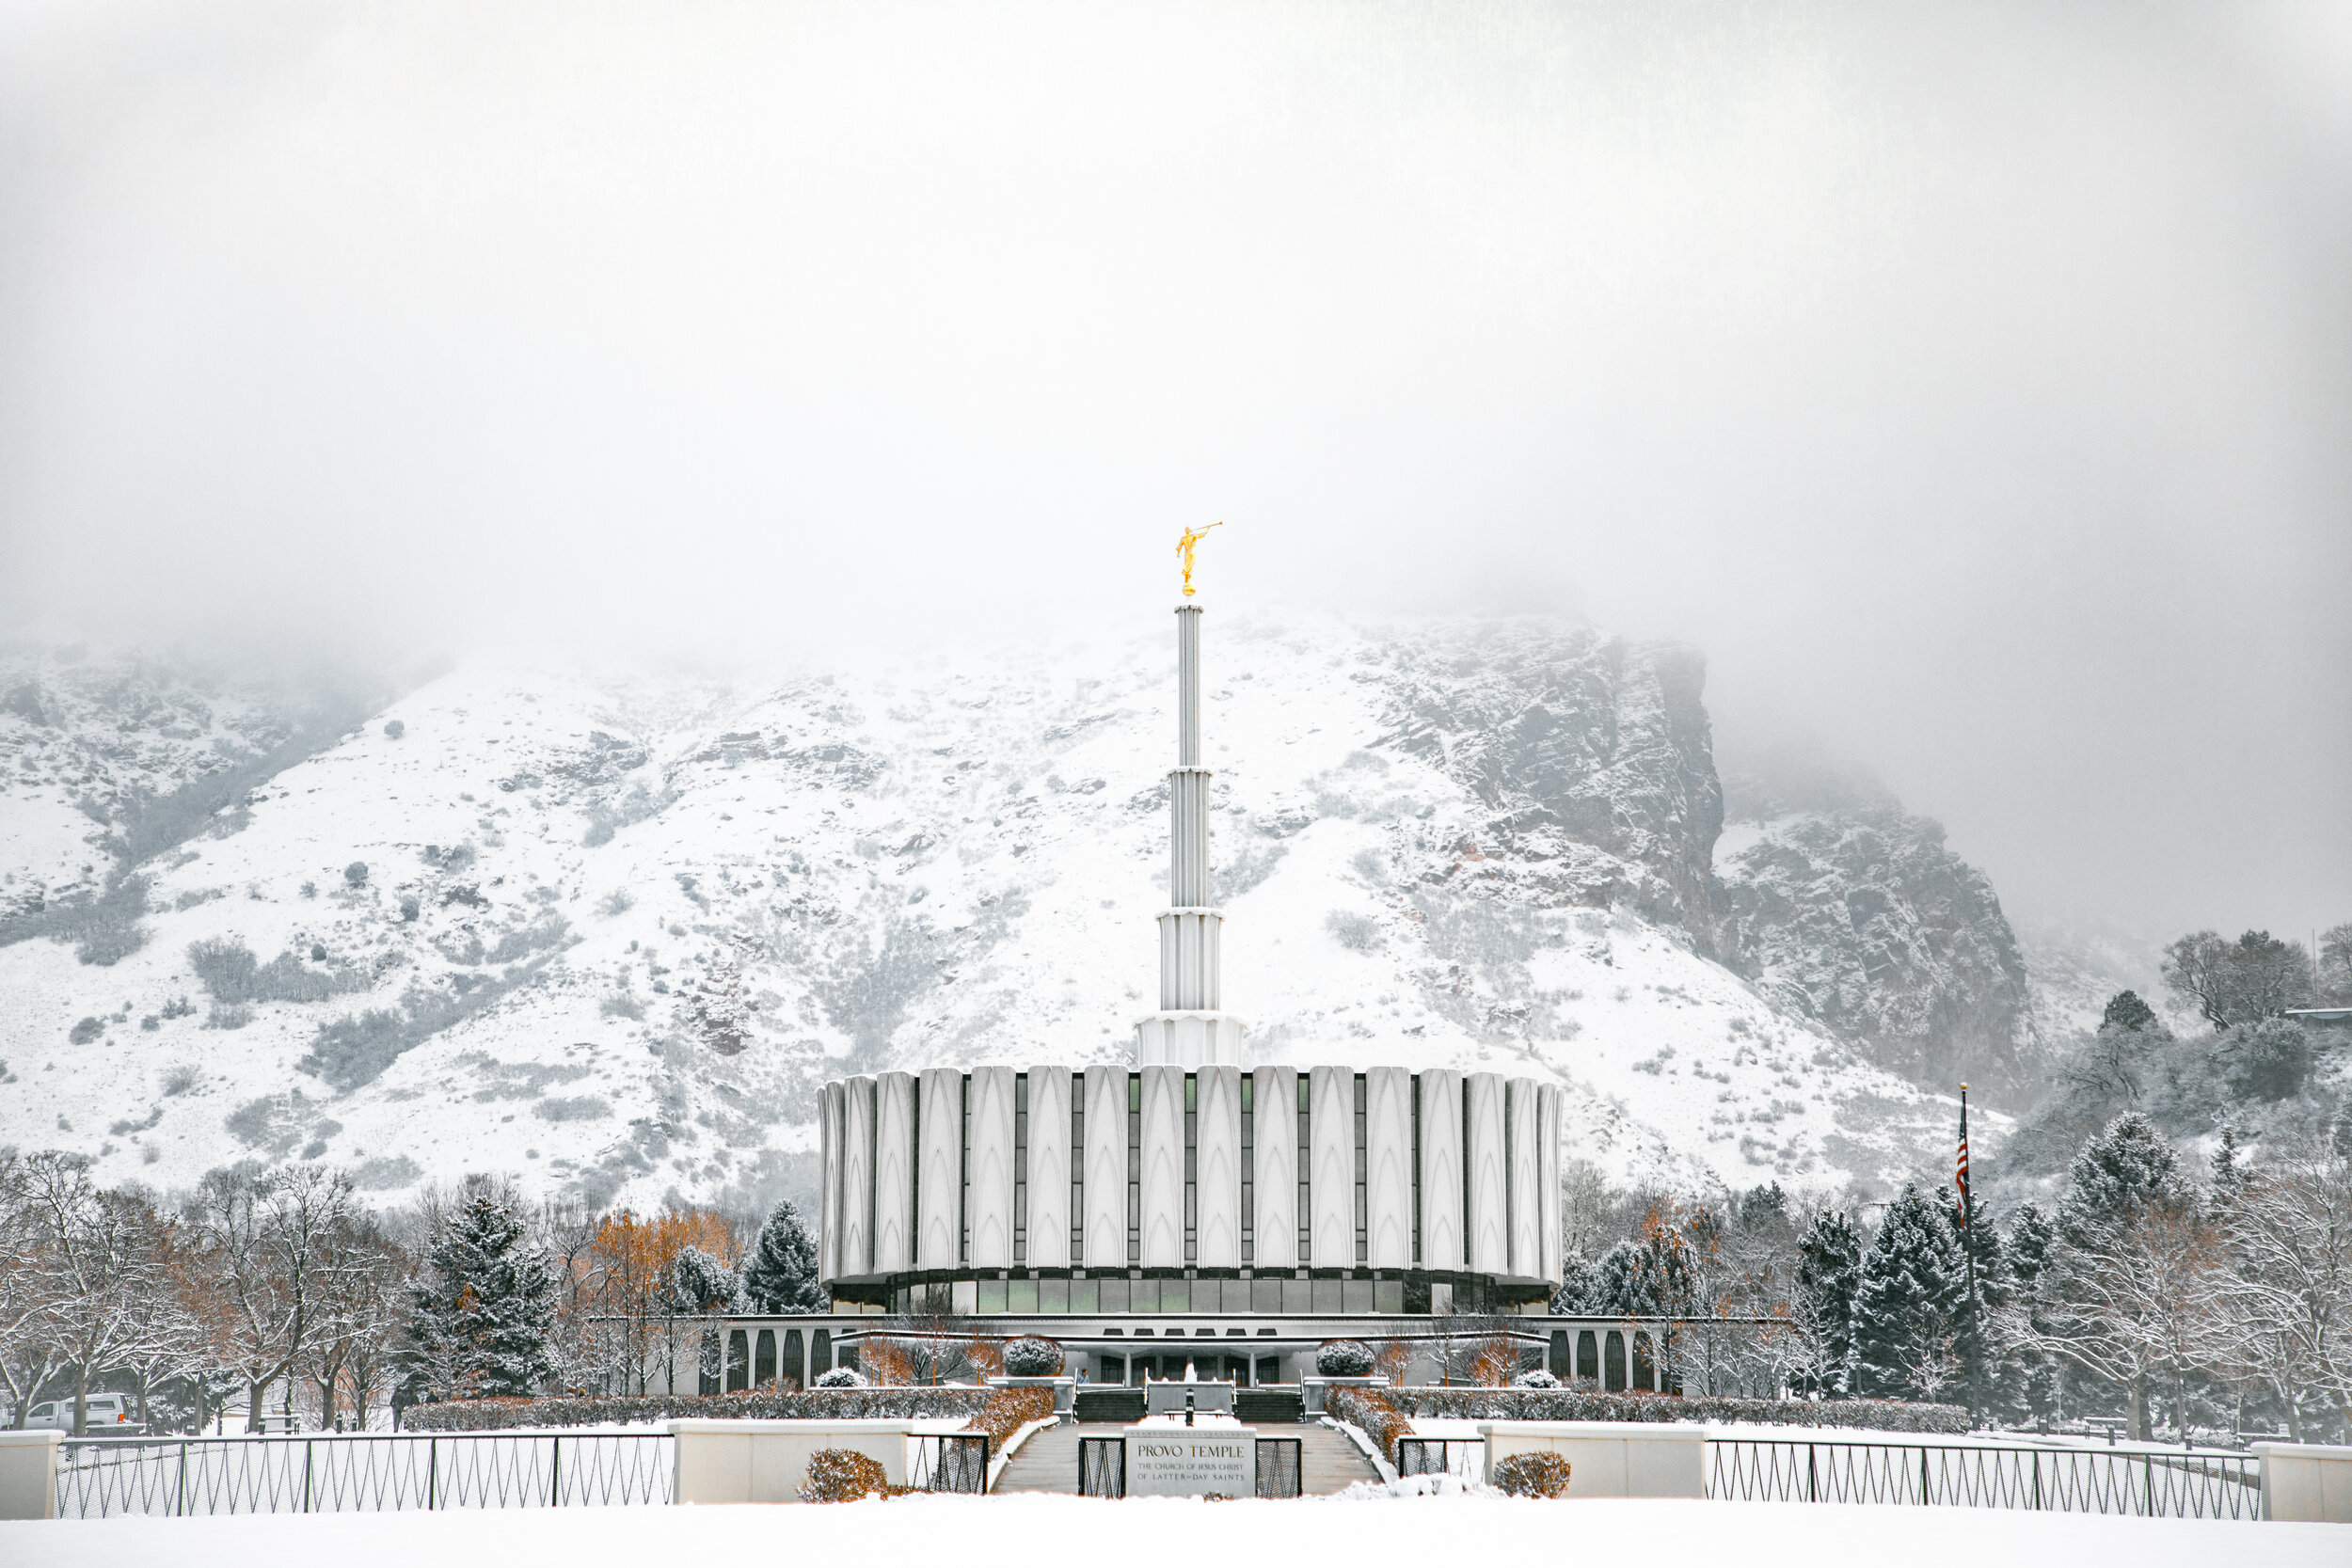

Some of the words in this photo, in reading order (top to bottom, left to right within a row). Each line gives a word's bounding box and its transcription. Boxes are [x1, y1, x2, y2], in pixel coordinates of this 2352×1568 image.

[1137, 1445, 1183, 1457] PROVO
[1189, 1445, 1244, 1458] TEMPLE
[1198, 1463, 1216, 1471] JESUS
[1218, 1463, 1243, 1471] CHRIST
